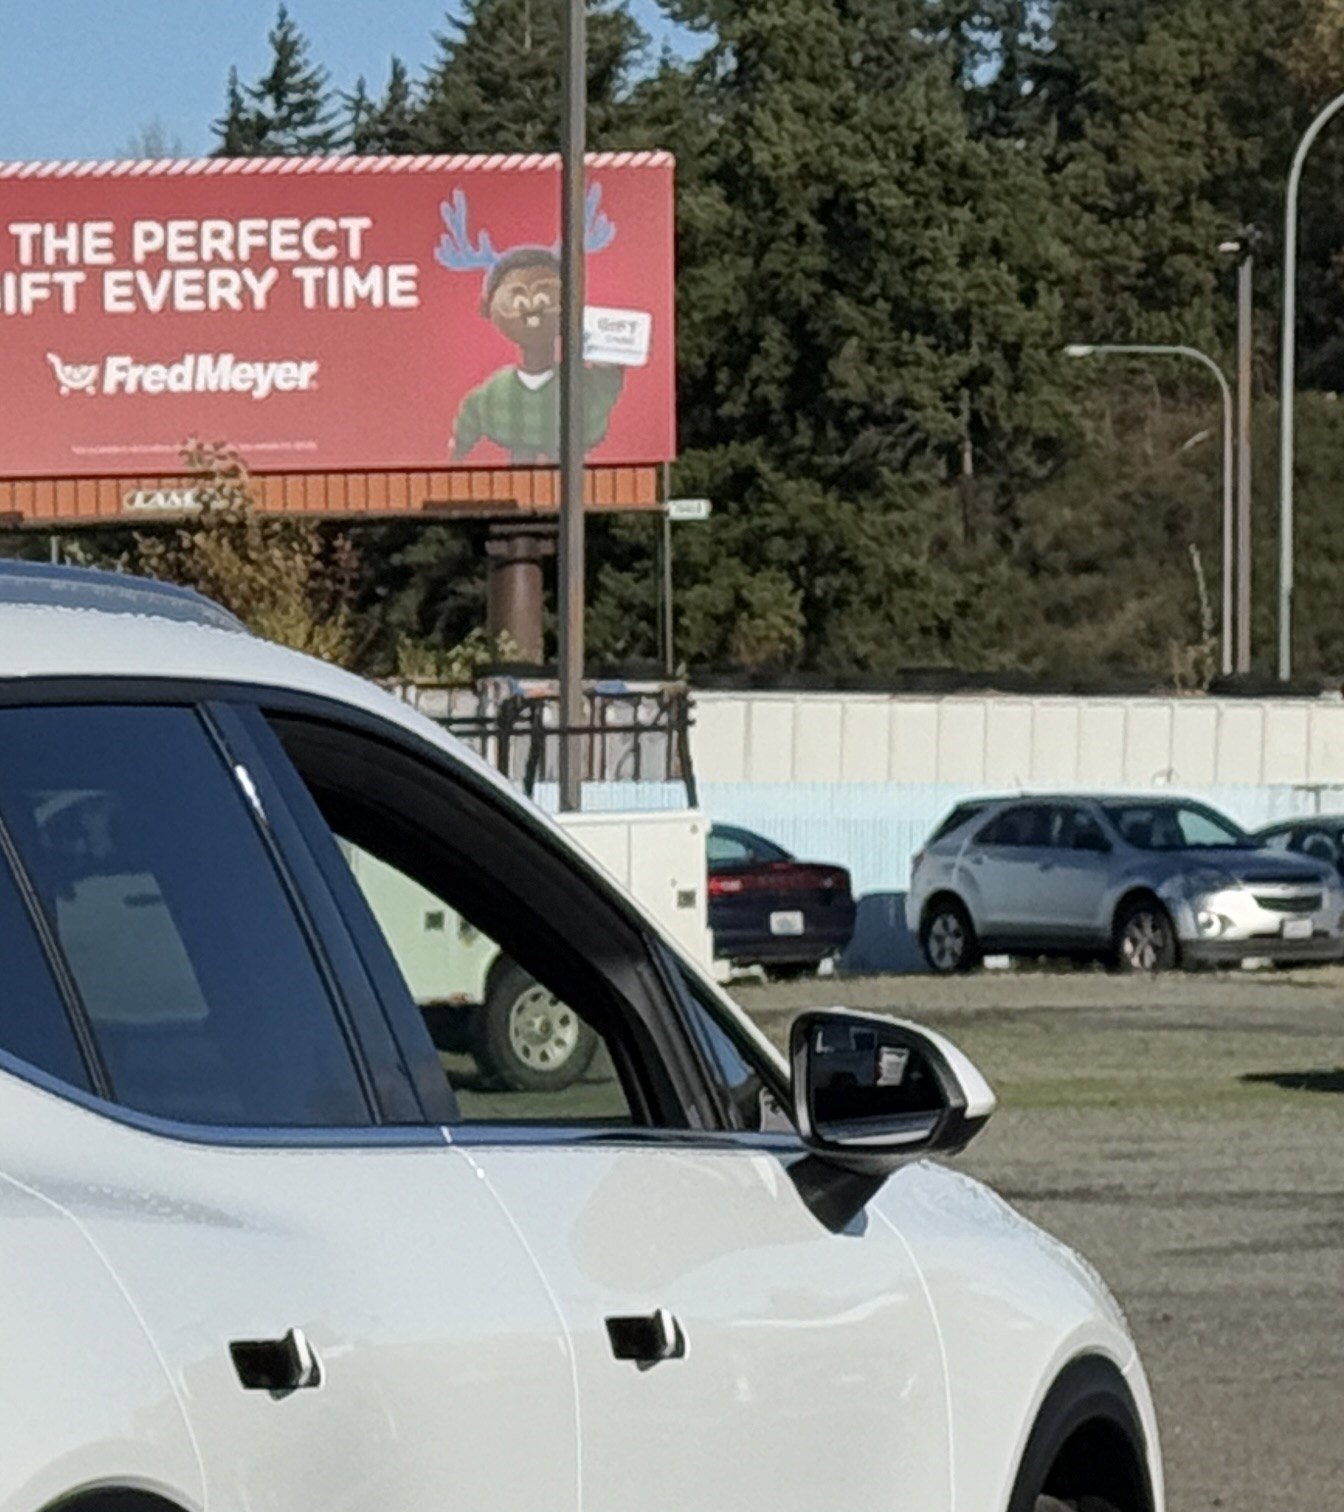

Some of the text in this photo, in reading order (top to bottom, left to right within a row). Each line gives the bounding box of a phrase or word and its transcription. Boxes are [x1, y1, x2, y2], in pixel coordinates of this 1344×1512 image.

[9, 217, 372, 265] THE PERFECT
[103, 266, 279, 313] EVERY
[293, 264, 420, 309] TIME
